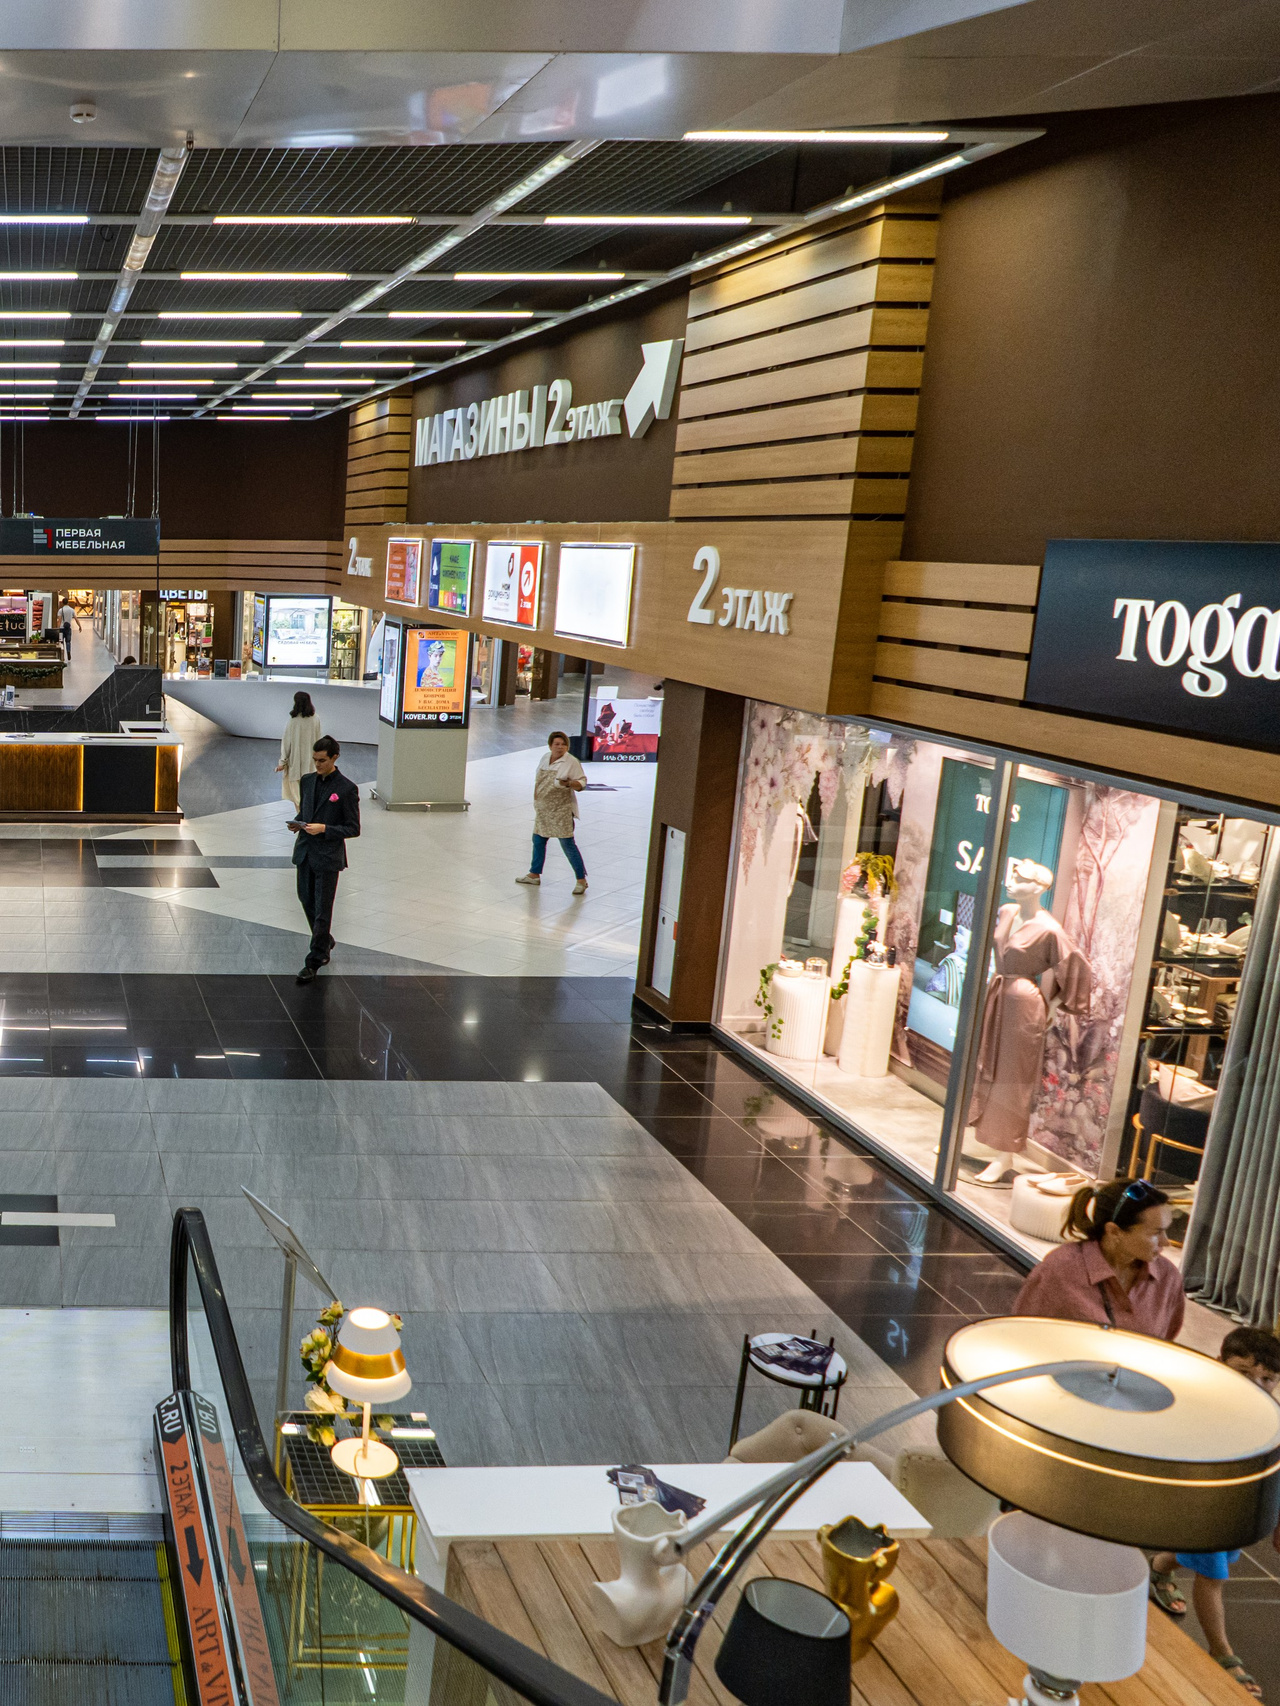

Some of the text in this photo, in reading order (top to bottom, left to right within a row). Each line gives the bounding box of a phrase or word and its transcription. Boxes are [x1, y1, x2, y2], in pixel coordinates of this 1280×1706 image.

[415, 379, 625, 467] МАГАЗИНЫ 2 ЭТАЖ
[55, 528, 102, 538] ПЕРВАЯ
[55, 540, 126, 550] МЕБЕЛЬНАЯ
[347, 537, 358, 576] 2
[687, 546, 794, 636] 2 ЭТАЖ
[404, 713, 437, 721] KOVER.RU
[170, 1460, 196, 1520] 2 ЭТАЖ
[192, 1606, 221, 1657] ART
